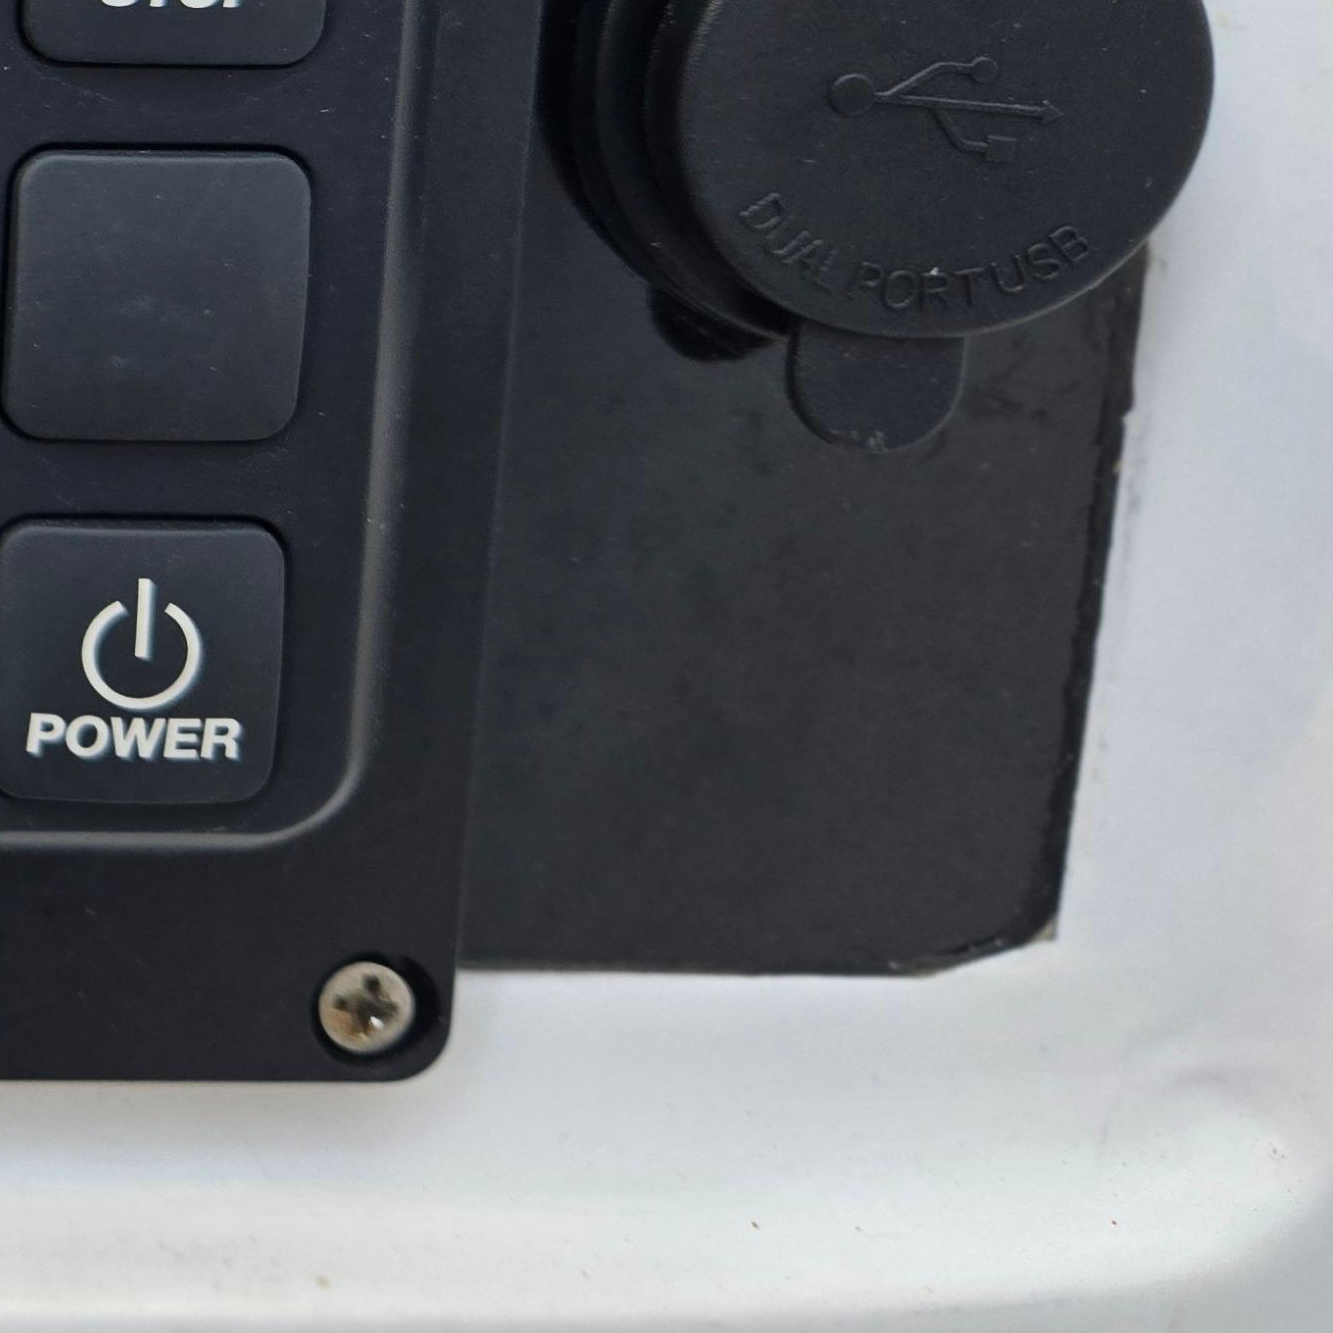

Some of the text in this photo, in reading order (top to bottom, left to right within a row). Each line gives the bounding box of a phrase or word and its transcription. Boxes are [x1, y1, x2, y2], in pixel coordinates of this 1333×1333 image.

[847, 261, 985, 310] PORT
[989, 225, 1090, 294] USB
[25, 713, 243, 761] POWER
